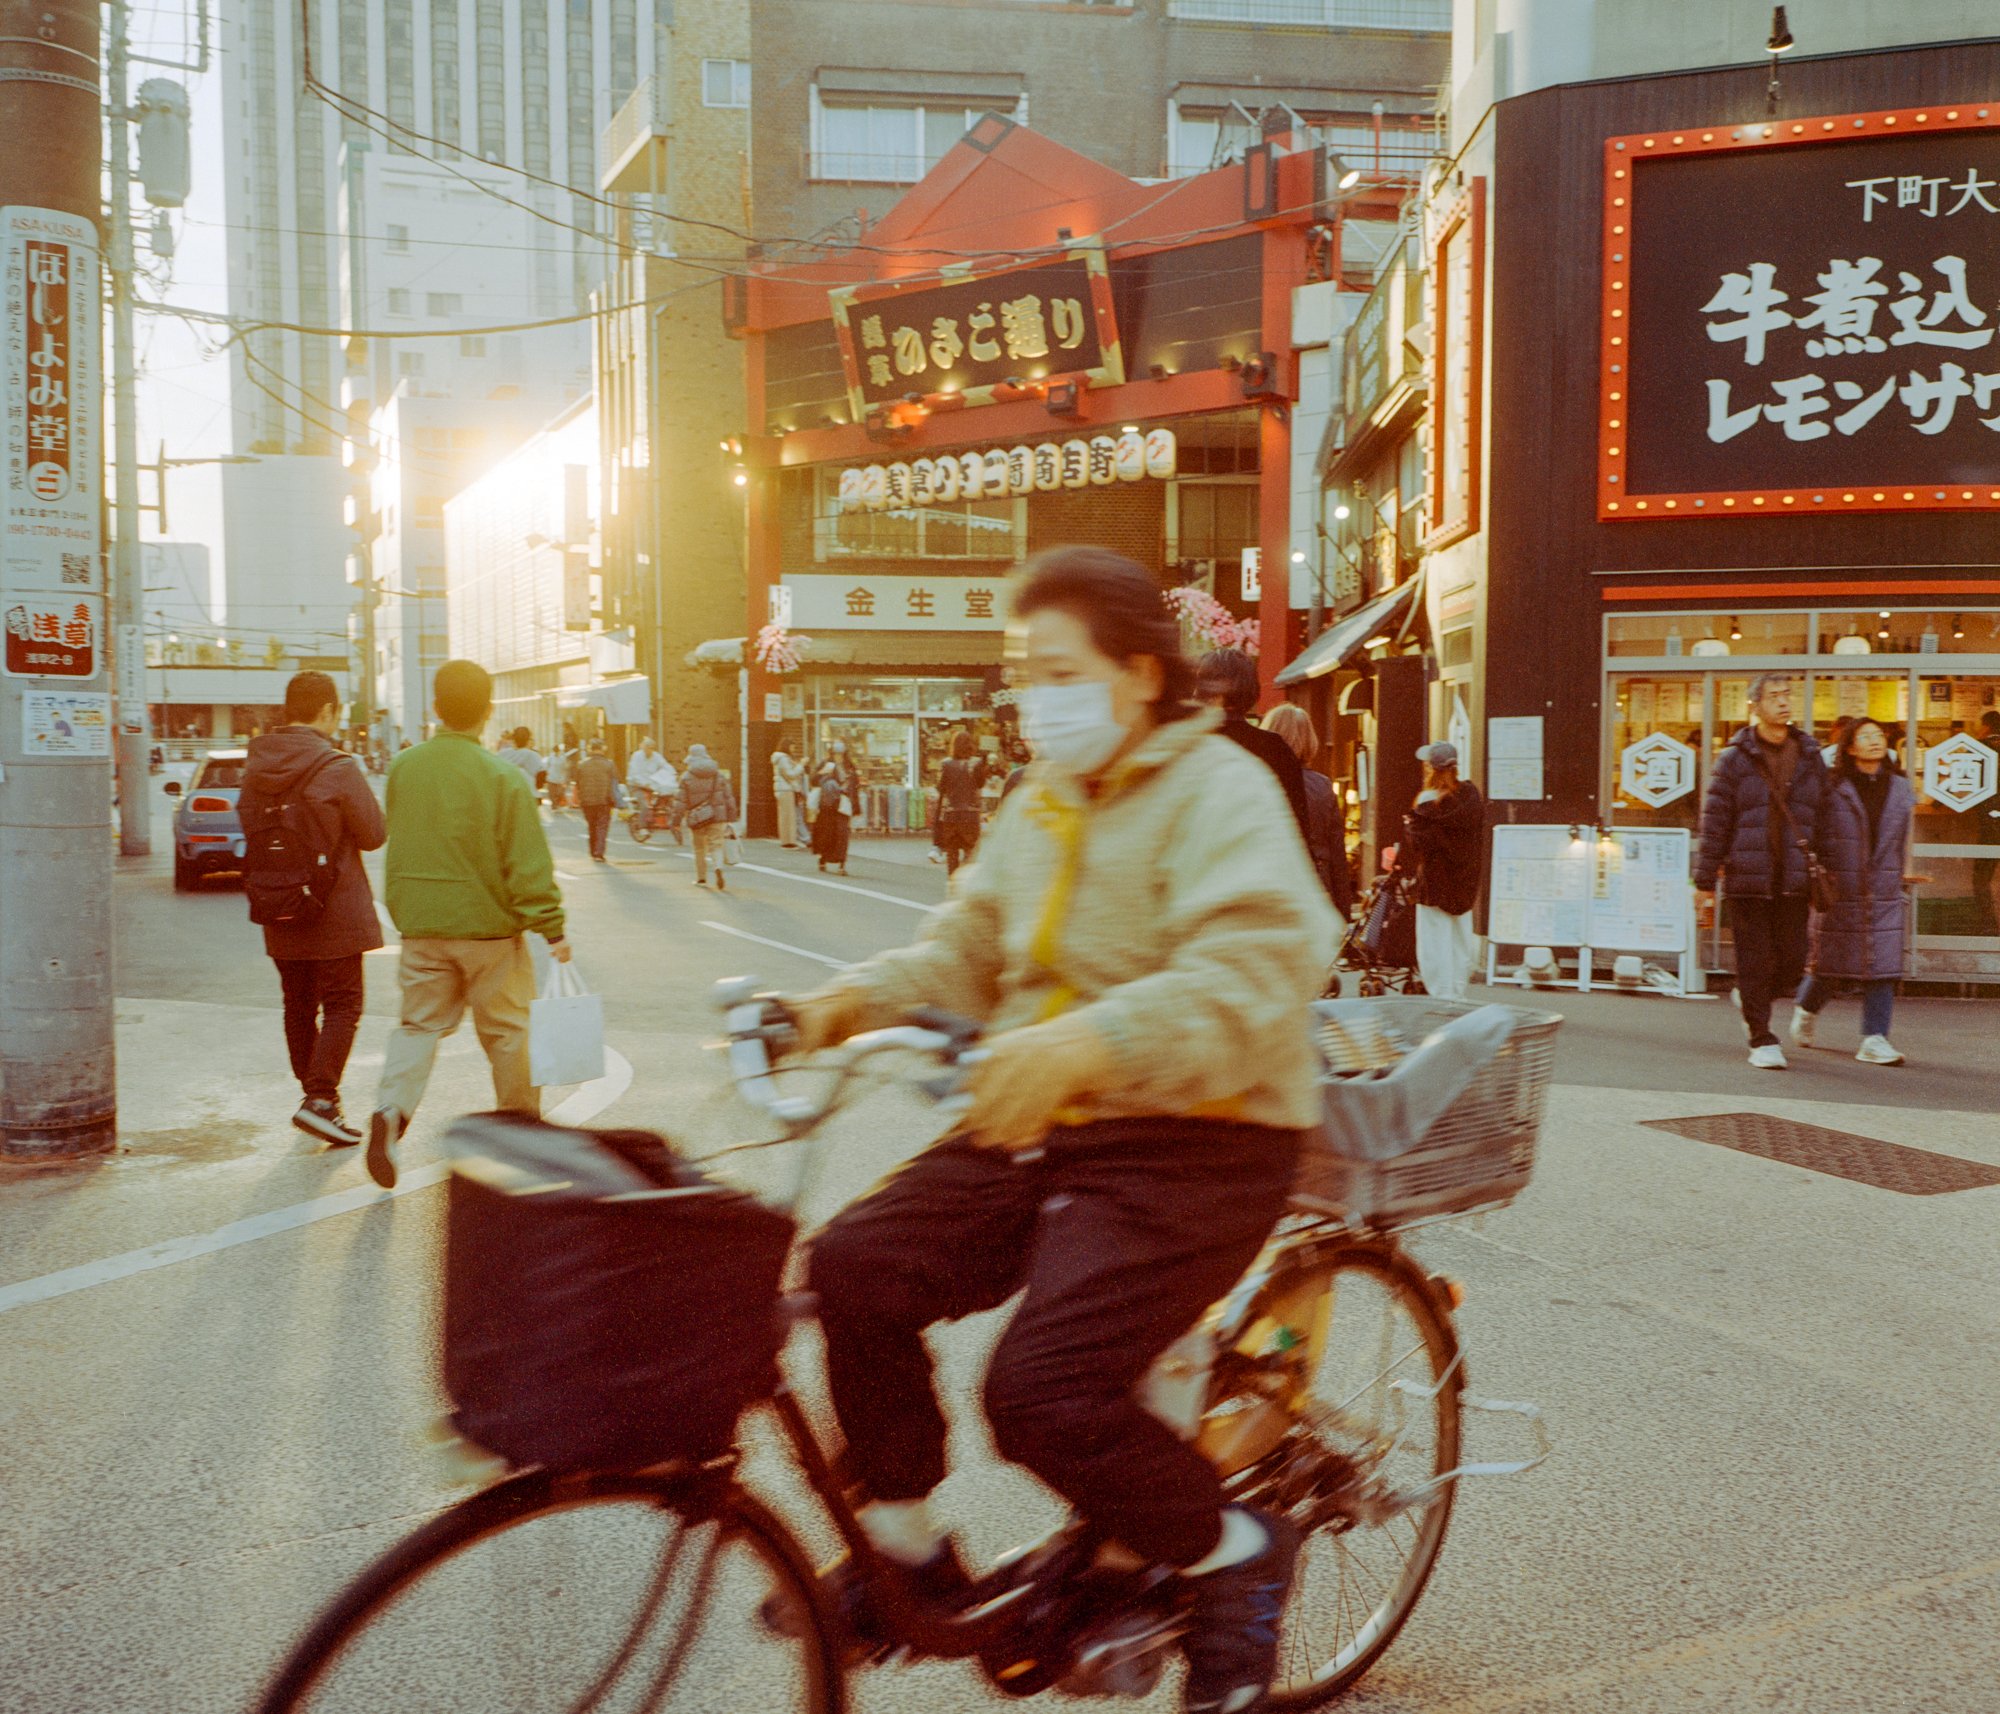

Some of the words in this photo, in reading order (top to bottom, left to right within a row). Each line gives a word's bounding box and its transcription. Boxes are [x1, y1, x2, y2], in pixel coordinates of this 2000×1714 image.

[28, 248, 68, 452] ほしよみ堂
[845, 586, 994, 618] 金生堂
[1634, 750, 1681, 789] 酒
[1936, 752, 1984, 792] 酒
